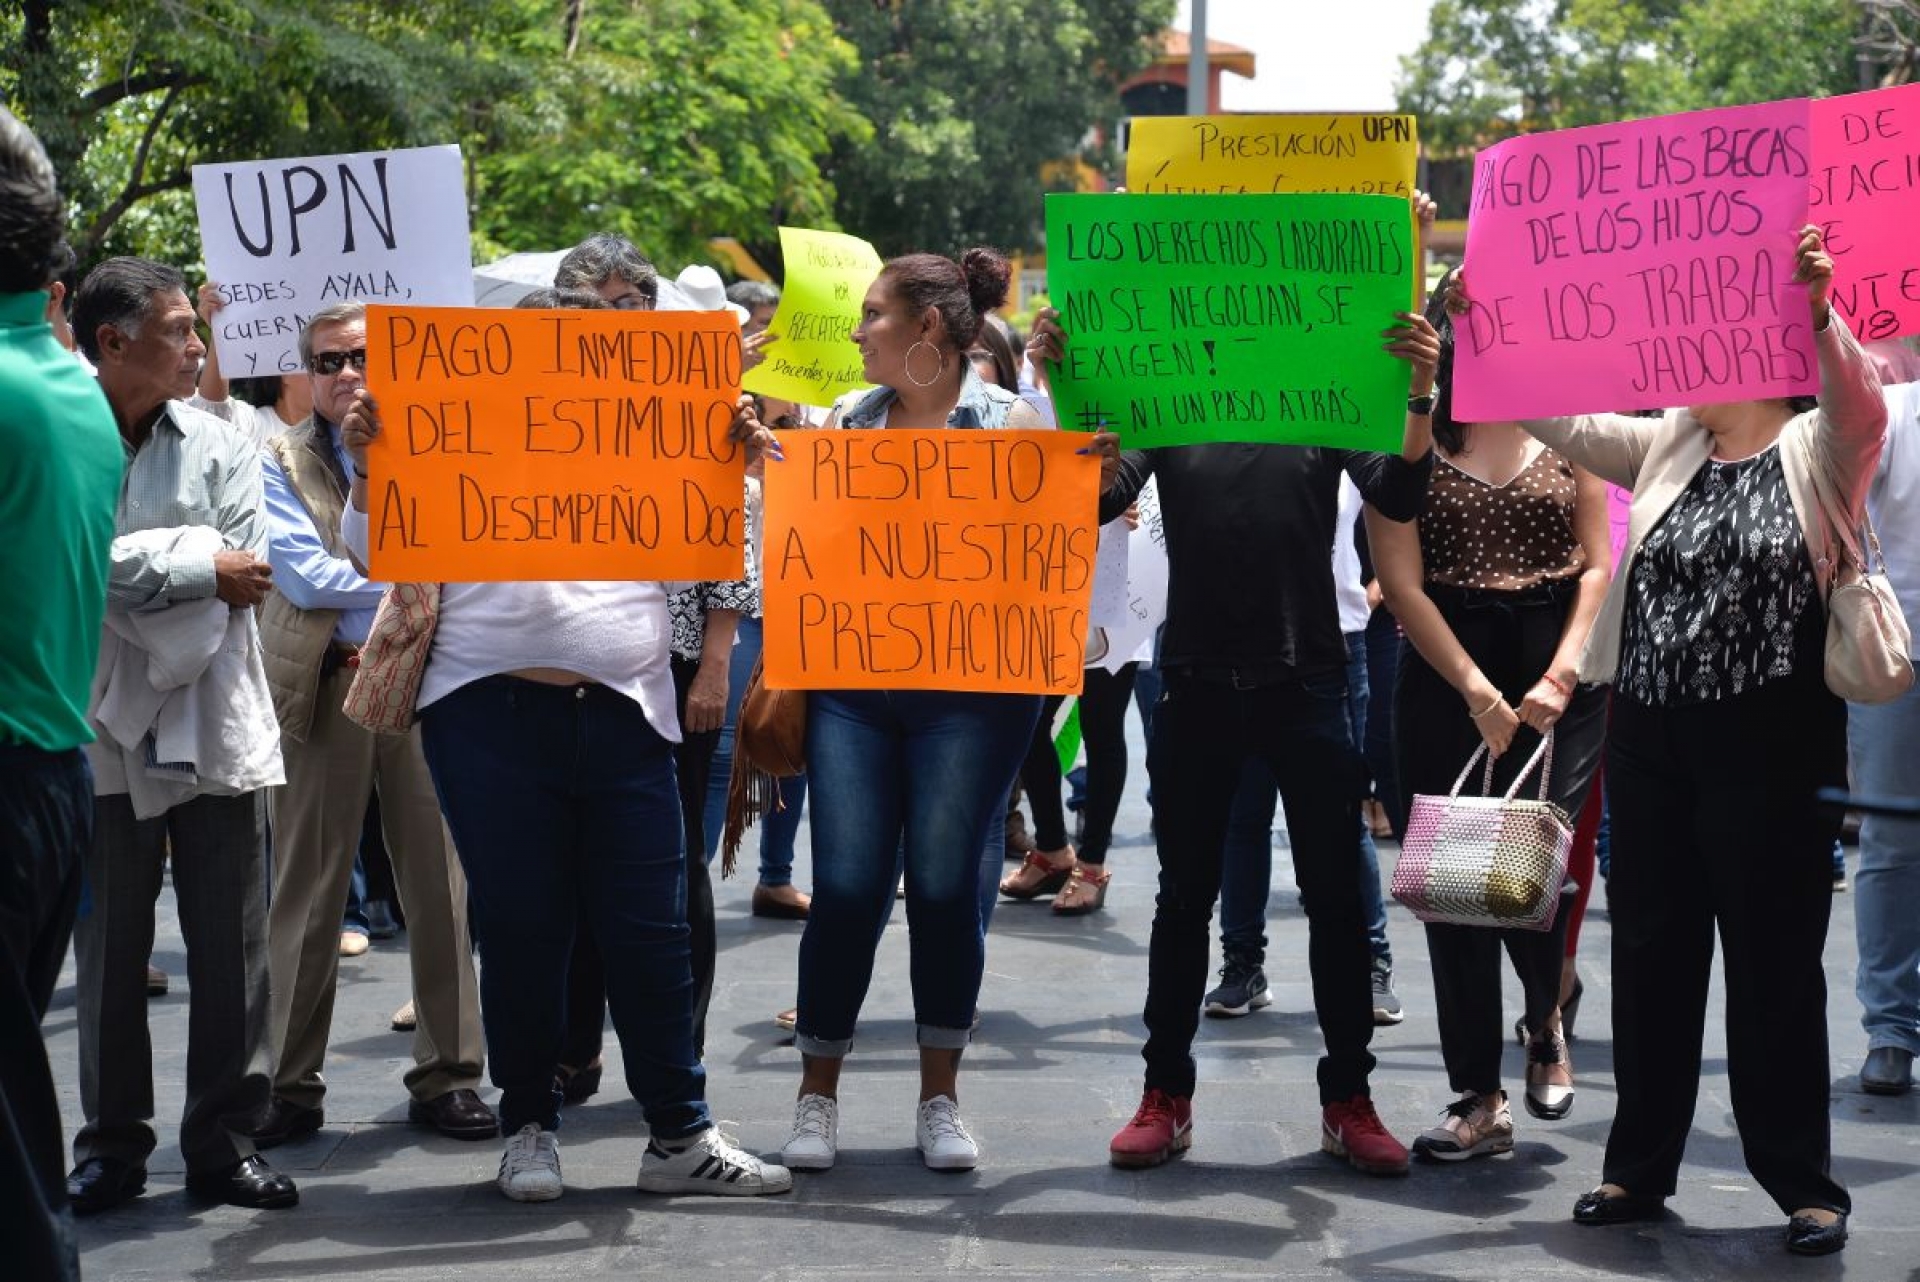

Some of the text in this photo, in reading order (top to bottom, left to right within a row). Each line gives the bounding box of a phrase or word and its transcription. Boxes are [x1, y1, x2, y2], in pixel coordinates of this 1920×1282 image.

[1193, 116, 1410, 161] PRESTACIÓN UPN
[1840, 108, 1903, 146] DE
[1473, 153, 1552, 216] PAGO
[1576, 140, 1621, 199] DE
[1637, 135, 1697, 195] LAS
[1700, 124, 1809, 180] BECAS
[223, 158, 397, 258] UPN
[1525, 190, 1763, 265] DE LOS HIJOS
[1066, 219, 1402, 276] LOS DERECHOS LABORALES
[218, 271, 413, 306] SEDES AYALA,
[1066, 284, 1355, 336] NO SE NEGOCIAN, SE
[1467, 296, 1520, 358] DE
[1543, 282, 1616, 342] LOS
[223, 313, 312, 340] CUERN
[388, 315, 742, 390] PAGO INMEDIATO
[1626, 323, 1810, 393] JADORES
[244, 349, 308, 375] Y G
[406, 395, 738, 465] DEL ESTIMULO
[1130, 396, 1162, 433] NI
[1174, 388, 1203, 425] UN
[1212, 389, 1265, 424] PASO
[812, 438, 1045, 503] RESPETO
[377, 480, 428, 552] AL
[458, 473, 660, 550] DESEMPEÑO
[780, 521, 1090, 595] A NUESTRAS
[798, 592, 1084, 689] PRESTACIONES
